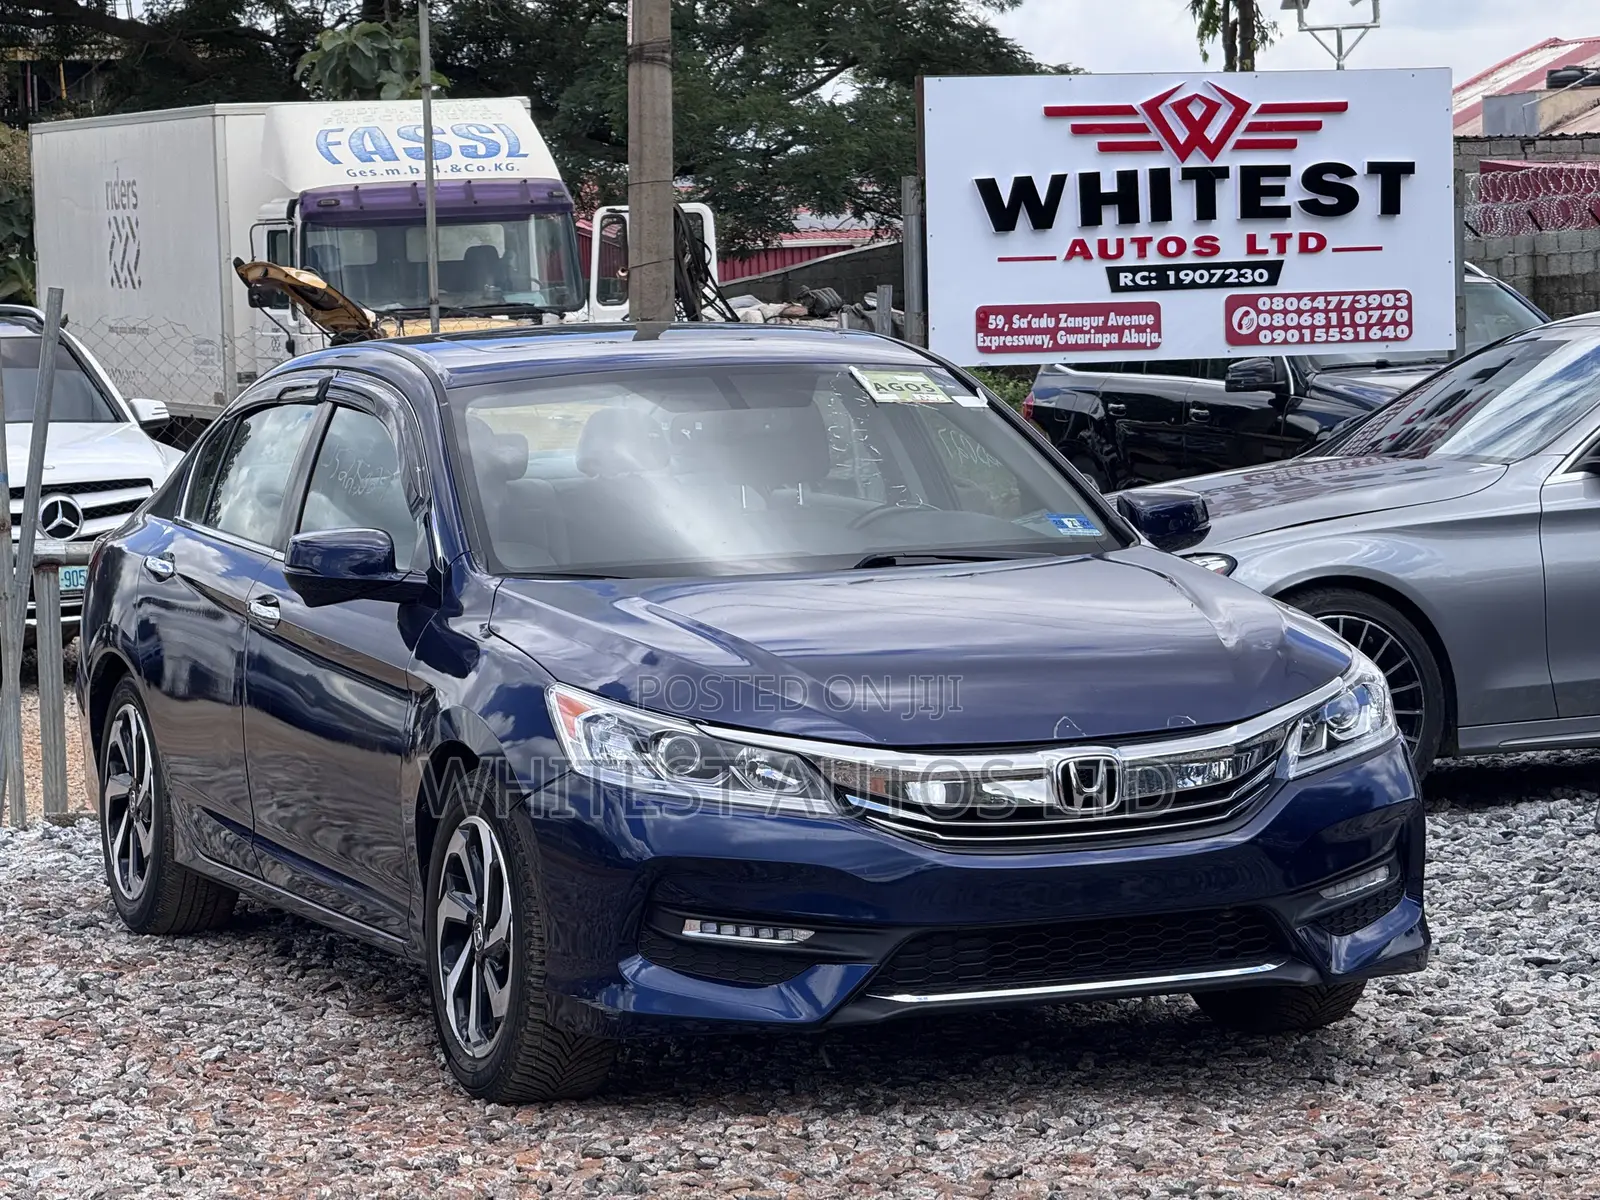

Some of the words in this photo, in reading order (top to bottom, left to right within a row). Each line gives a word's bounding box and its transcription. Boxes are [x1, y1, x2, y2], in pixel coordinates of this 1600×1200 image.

[316, 123, 529, 165] FASSL
[105, 166, 138, 211] riders
[973, 161, 1416, 233] WHITEST
[1063, 234, 1221, 261] AUTOS
[1246, 232, 1328, 255] LTD
[1119, 272, 1157, 287] RC:
[1167, 268, 1269, 285] 1907230
[1257, 293, 1408, 311] 08064773903
[988, 314, 1010, 331] 59,
[1058, 313, 1105, 330] Zangur
[1107, 312, 1155, 326] Avenue
[1258, 308, 1409, 327] 08068110770
[977, 333, 1053, 350] Expressway,
[1057, 330, 1119, 347] Gwarinpa
[1122, 328, 1162, 346] Abuja.
[1258, 324, 1409, 344] 09015531640
